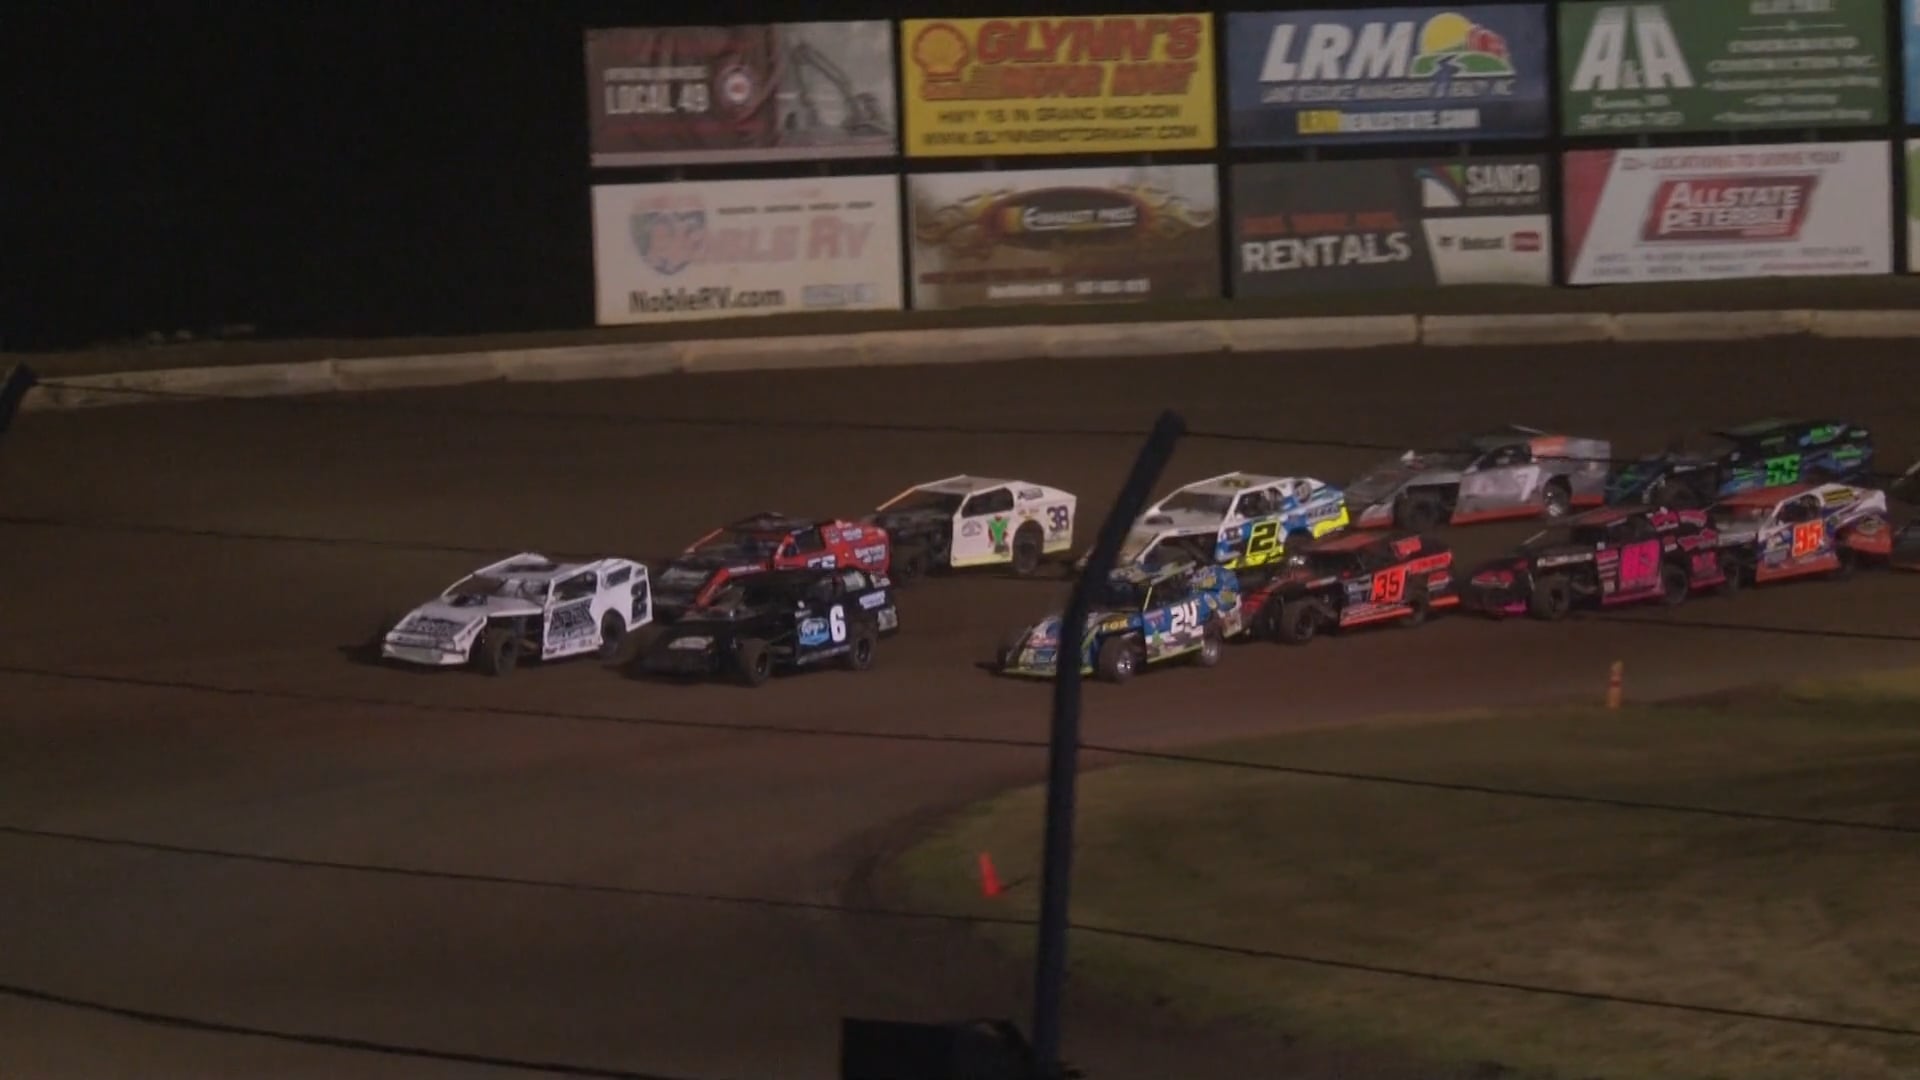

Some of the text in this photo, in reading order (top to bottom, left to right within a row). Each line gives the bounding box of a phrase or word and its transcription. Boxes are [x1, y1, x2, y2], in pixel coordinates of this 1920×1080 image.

[976, 16, 1201, 63] GLYNN'S
[1258, 21, 1415, 82] LRM
[605, 82, 709, 115] LOCAL 49
[1466, 164, 1541, 194] SANCO
[1666, 181, 1801, 209] ALLSTATE
[1658, 207, 1797, 236] PETERBILT
[1241, 232, 1412, 273] RENTALS
[628, 286, 786, 313] NobleRV.com
[1046, 505, 1070, 532] 38
[1249, 519, 1280, 554] 2
[1374, 572, 1401, 602] 35
[829, 603, 847, 643] 6
[1170, 601, 1199, 634] 24
